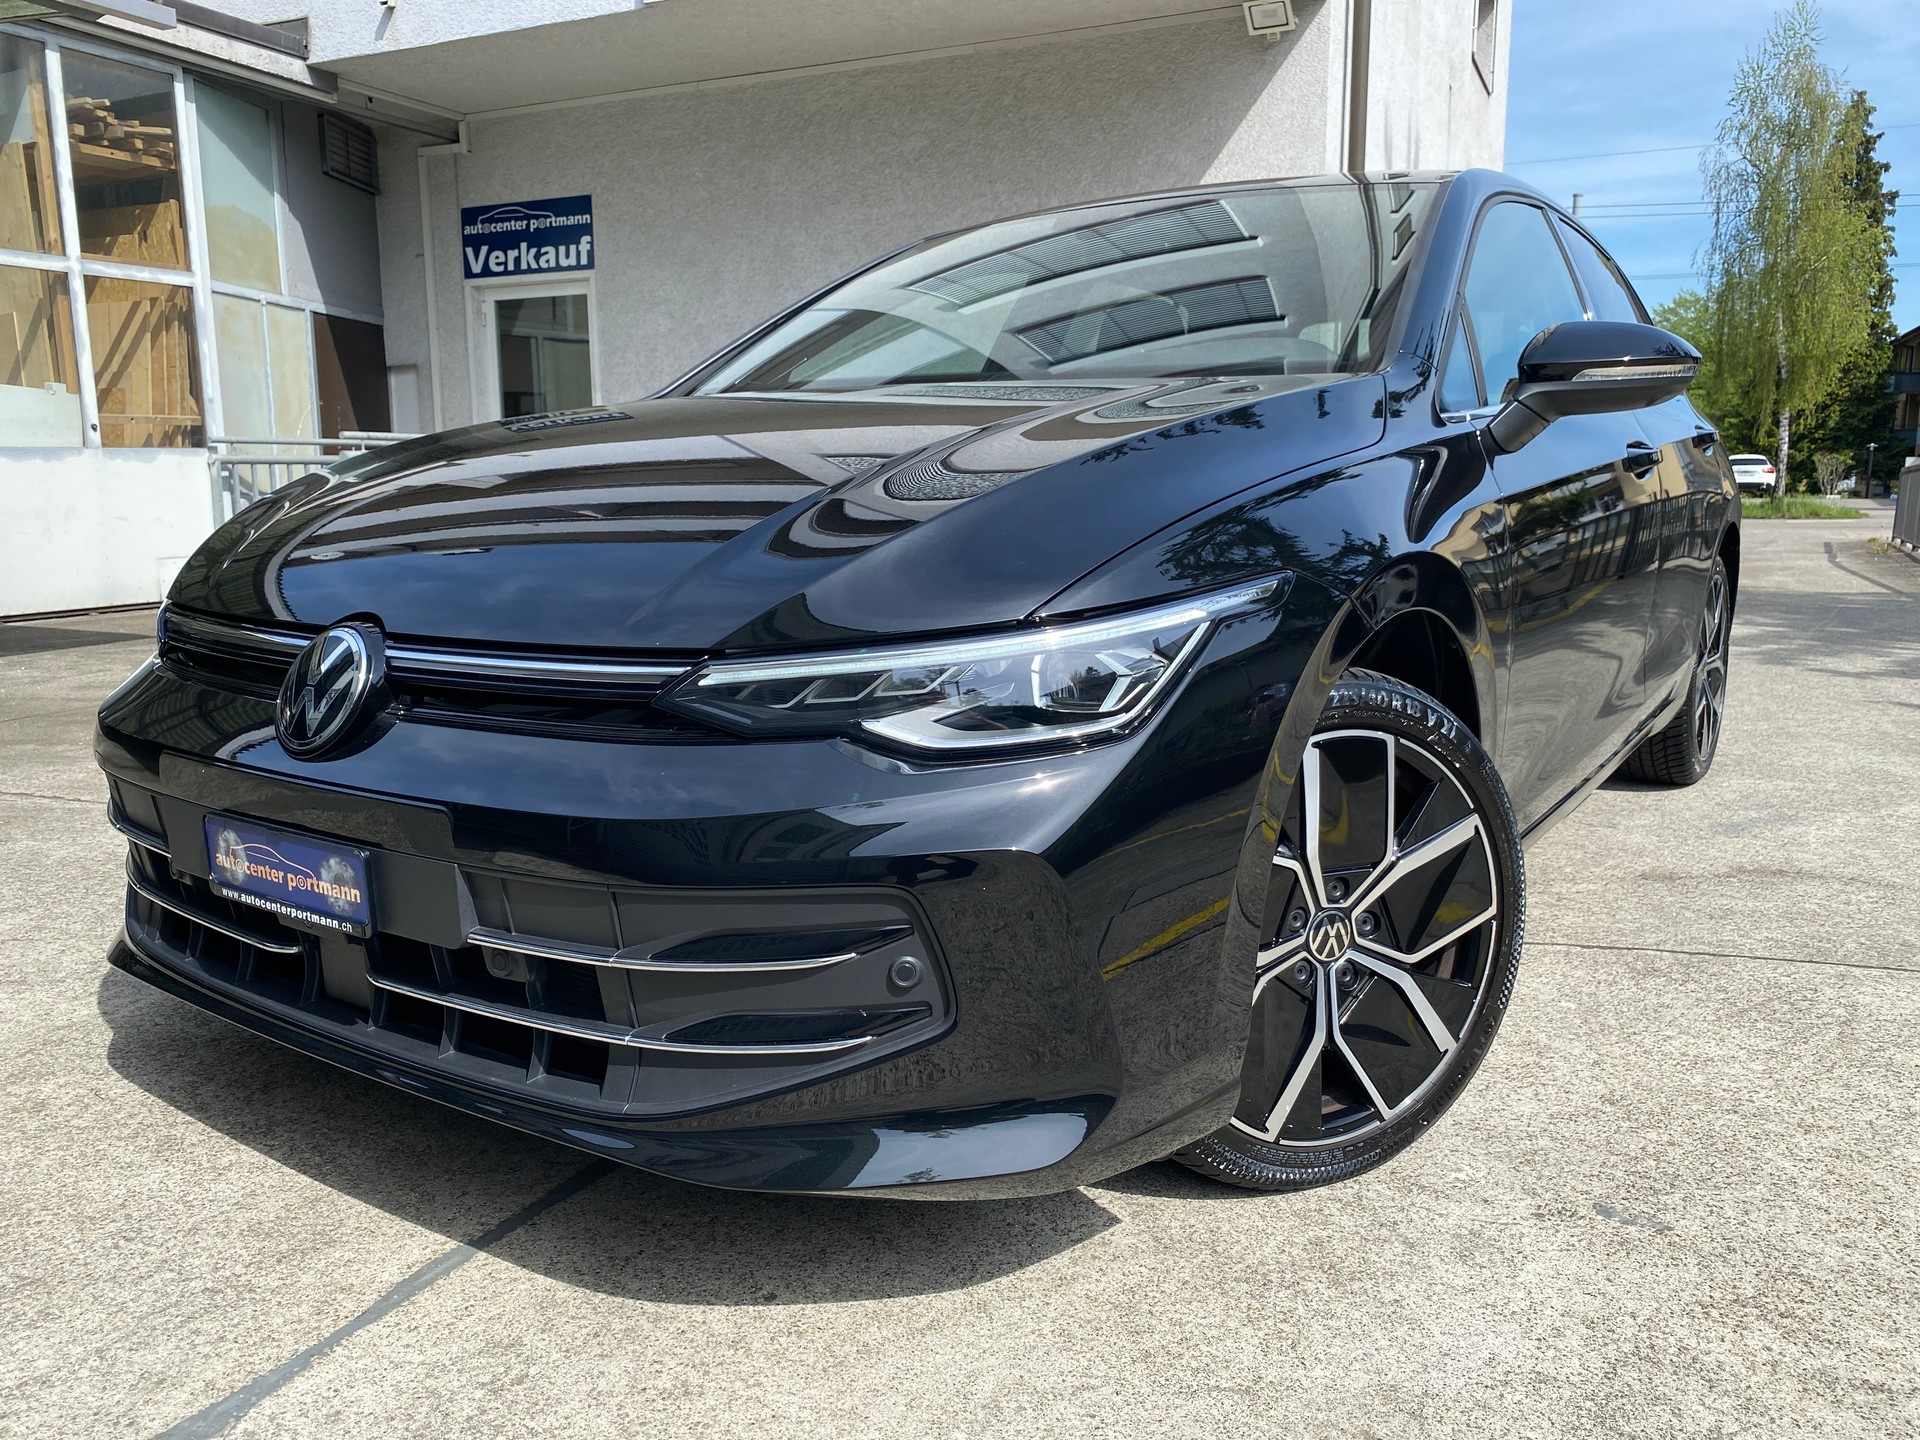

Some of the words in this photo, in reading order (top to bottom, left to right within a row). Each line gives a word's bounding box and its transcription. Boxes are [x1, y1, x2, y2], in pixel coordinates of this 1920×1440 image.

[464, 219, 526, 235] autocenter
[530, 214, 591, 232] portmann
[465, 235, 592, 274] Verkauf
[215, 852, 284, 884] autocenter
[287, 874, 361, 903] portmann
[221, 887, 353, 933] www.autocenterportmann.ch
